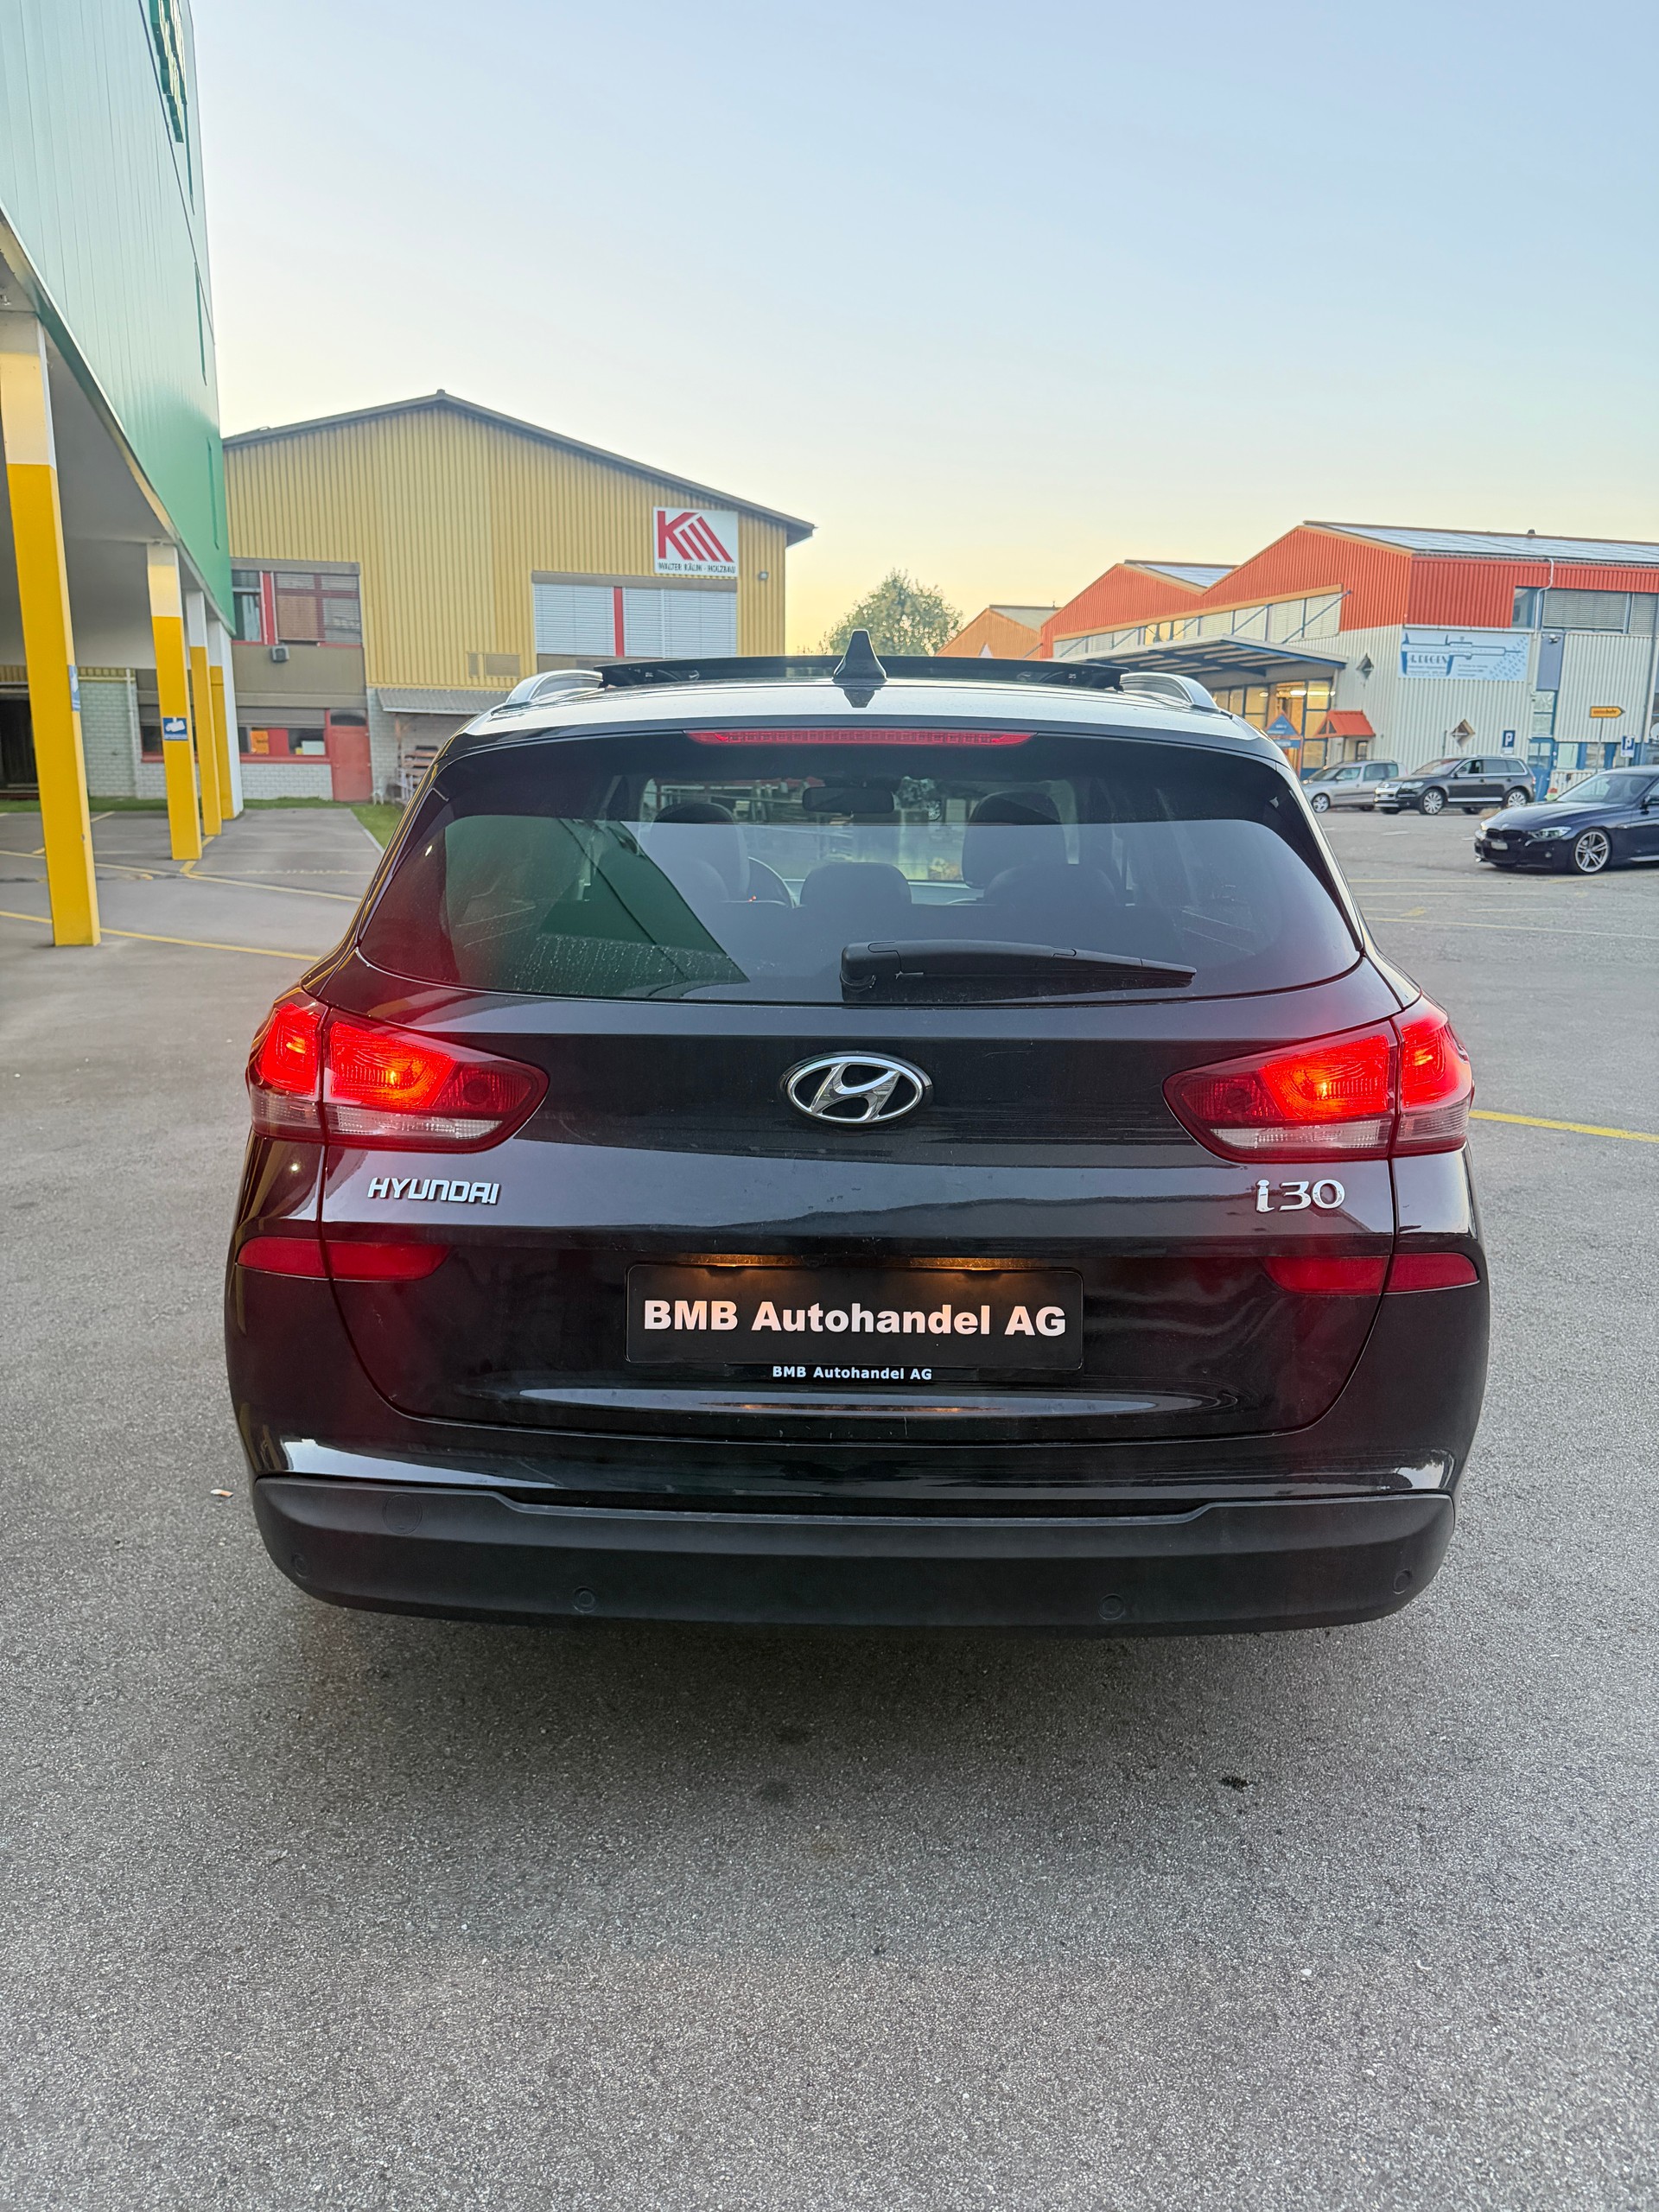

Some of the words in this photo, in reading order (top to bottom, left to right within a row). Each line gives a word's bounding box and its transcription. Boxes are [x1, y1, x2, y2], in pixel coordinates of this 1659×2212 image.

[658, 563, 682, 571] WALTER
[708, 564, 736, 574] HOLZBAU
[1505, 732, 1513, 747] P
[1624, 736, 1632, 750] P
[366, 1177, 500, 1205] HYUNDAI
[1255, 1179, 1346, 1213] i30
[644, 1300, 739, 1331] BMB
[751, 1300, 991, 1336] Autohandel
[1003, 1305, 1066, 1337] AG
[772, 1365, 807, 1378] BMB
[812, 1365, 905, 1380] Autohandel
[909, 1367, 932, 1380] AG
